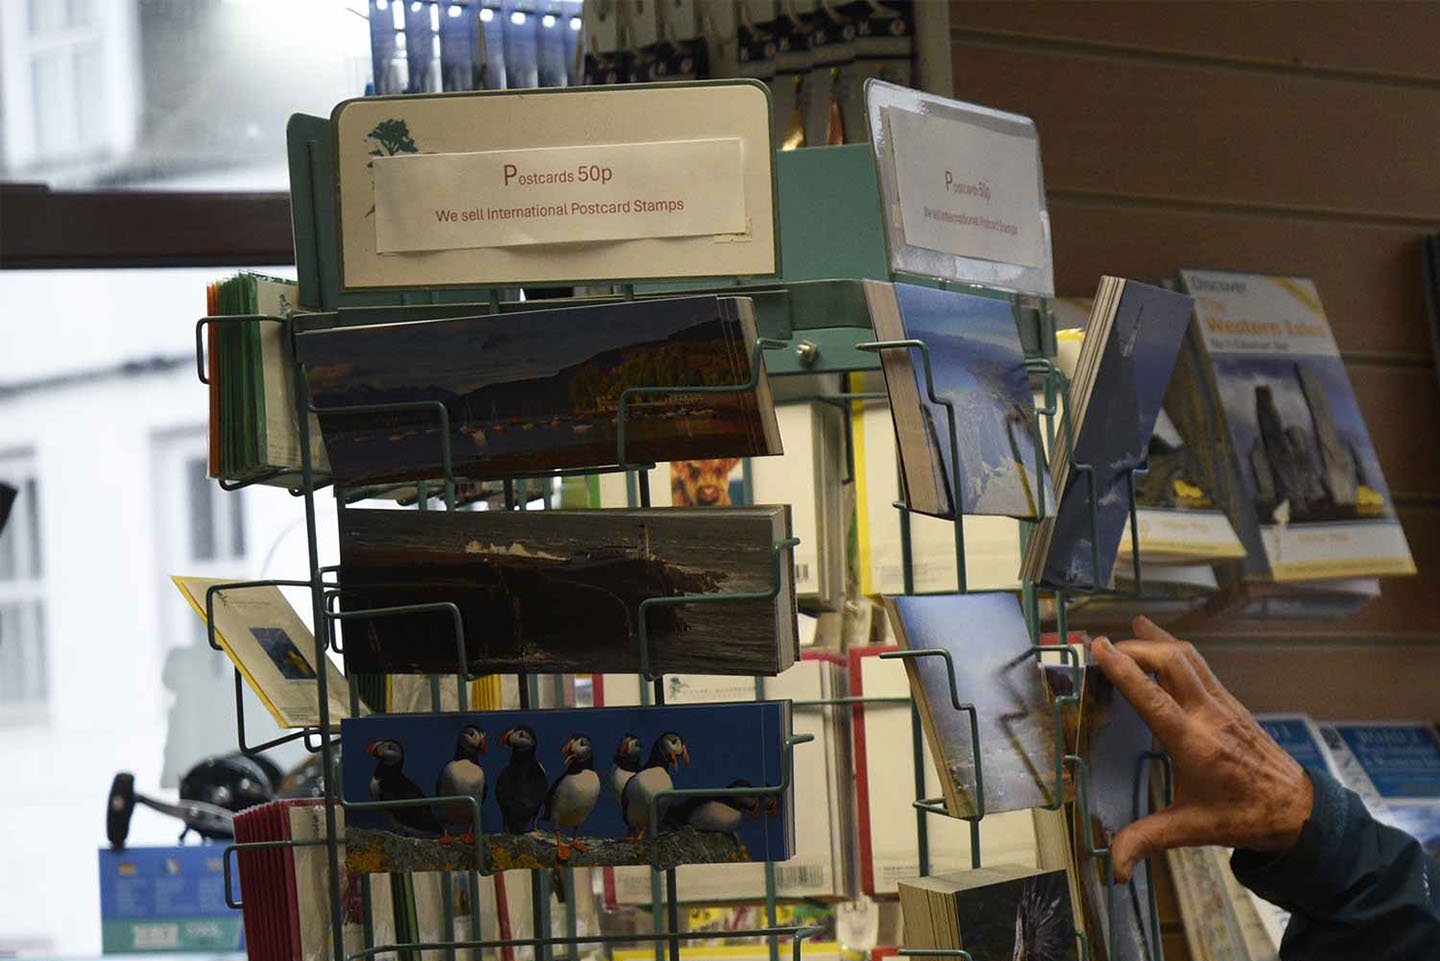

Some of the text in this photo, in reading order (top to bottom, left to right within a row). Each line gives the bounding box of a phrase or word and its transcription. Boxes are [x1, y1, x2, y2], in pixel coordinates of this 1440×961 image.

[503, 163, 613, 186] Postcards 50p
[435, 199, 685, 223] We sell International Postcard Stamps
